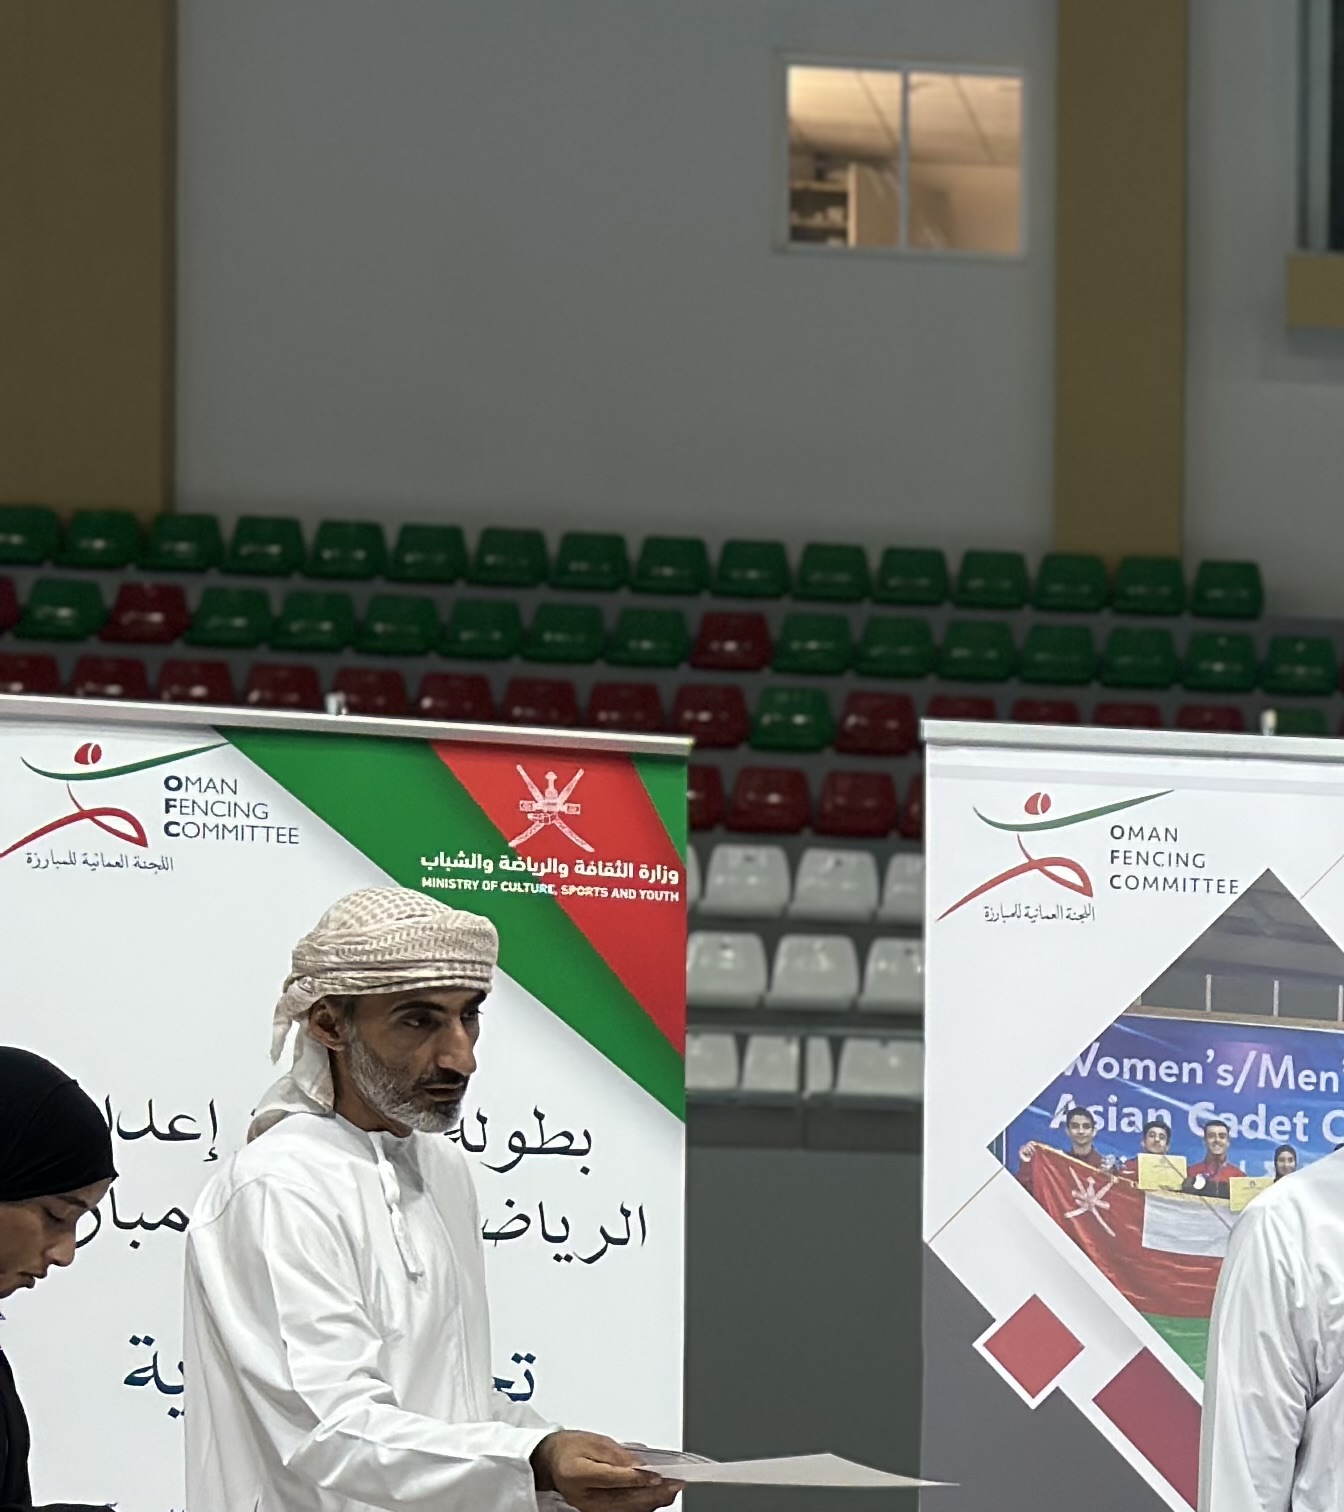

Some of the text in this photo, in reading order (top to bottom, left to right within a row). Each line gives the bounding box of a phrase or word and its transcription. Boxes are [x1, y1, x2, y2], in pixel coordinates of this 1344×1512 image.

[164, 775, 237, 795] OMAN
[165, 798, 268, 819] FENCING
[164, 821, 299, 844] COMMITTEE
[1110, 825, 1177, 842] OMAN
[26, 850, 173, 874] اللجنة العمانية للمبارزة
[421, 851, 678, 884] وزارة الثقافة والرياضة والشباب
[1111, 850, 1205, 868] FENCING
[422, 877, 479, 890] MINISTRY
[482, 880, 498, 891] OF
[561, 885, 608, 897] SPORTS
[611, 888, 636, 899] AND
[639, 889, 679, 901] YOUTH
[1110, 875, 1238, 894] COMMITTEE
[984, 903, 1094, 923] اللجنة العمانية للمبارزة
[105, 1092, 220, 1166] إعدا
[482, 1196, 648, 1266] الرياض
